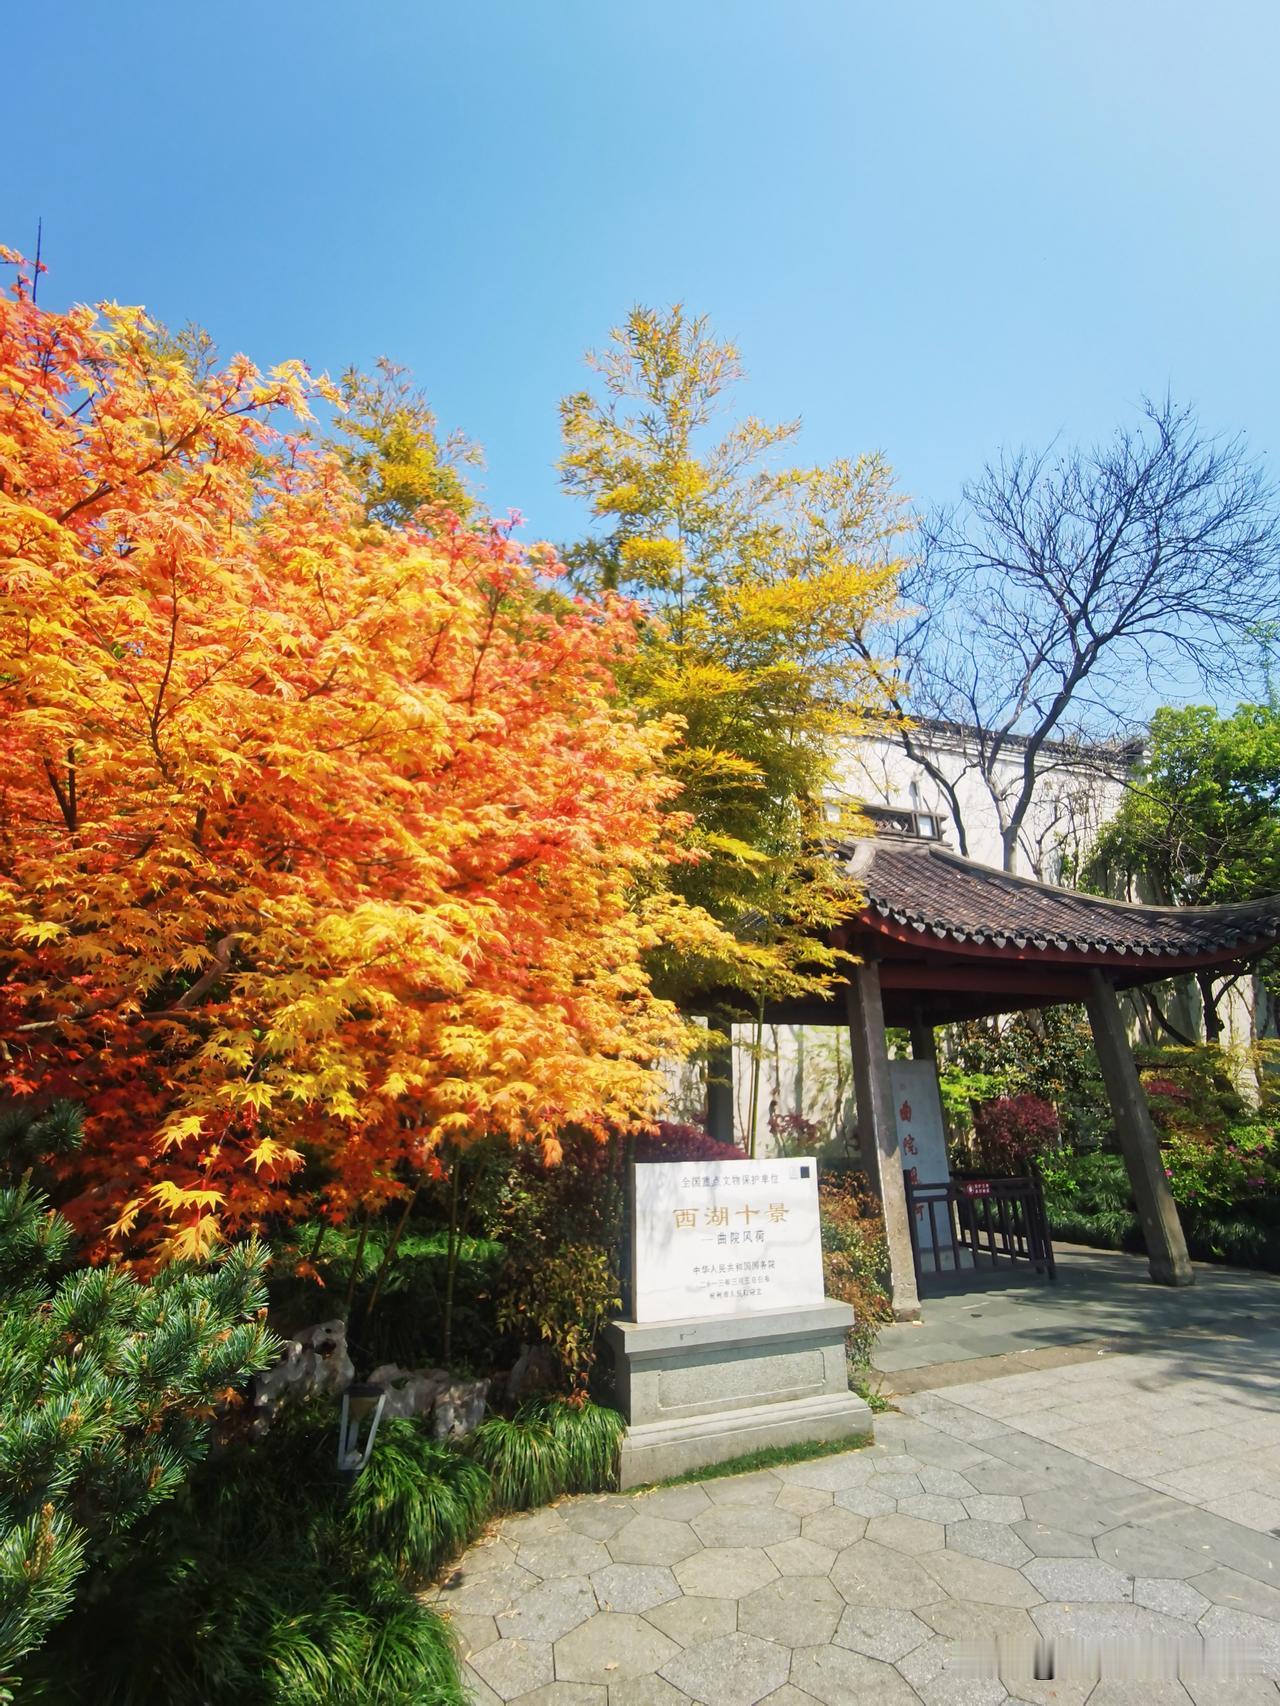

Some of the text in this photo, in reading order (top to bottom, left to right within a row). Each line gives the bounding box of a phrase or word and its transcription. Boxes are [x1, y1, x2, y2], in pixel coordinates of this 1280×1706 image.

[898, 1100, 926, 1222] 曲院
[681, 1173, 779, 1189] 全国重点文物保护单位
[672, 1202, 790, 1228] 西湖十景
[693, 1259, 775, 1275] 中华人民共和国国务院
